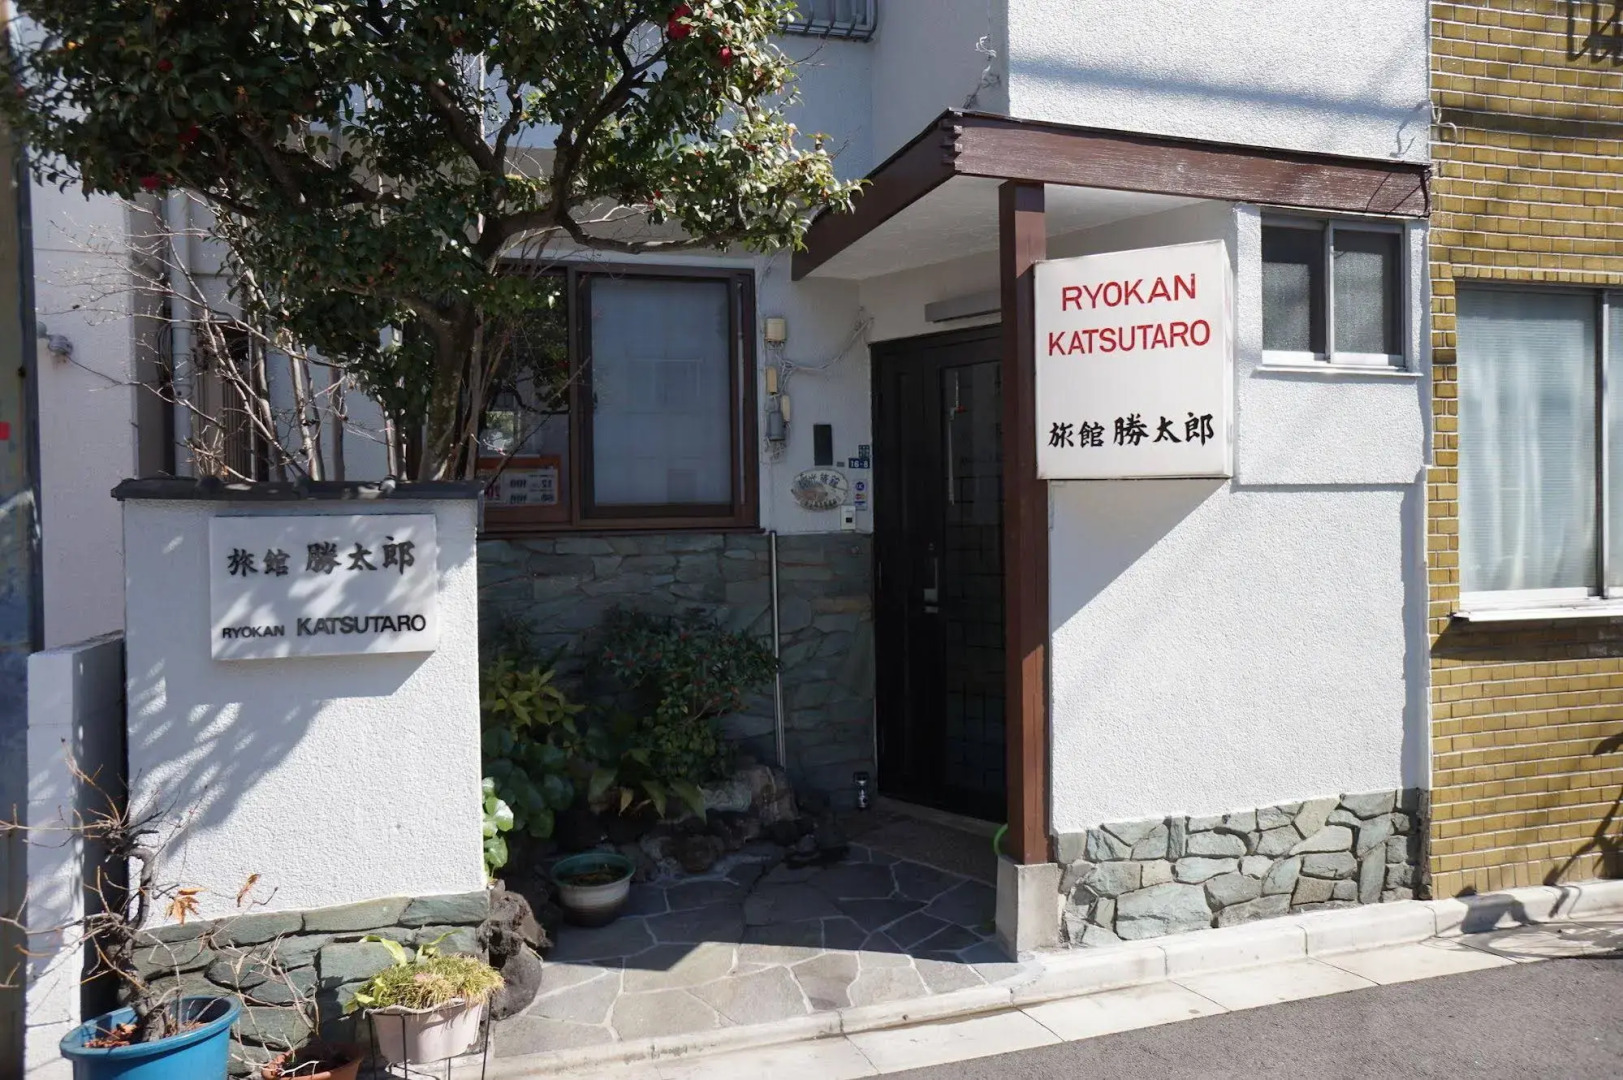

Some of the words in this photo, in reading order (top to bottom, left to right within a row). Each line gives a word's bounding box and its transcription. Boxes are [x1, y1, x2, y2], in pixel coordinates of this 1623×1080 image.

[1062, 273, 1196, 312] RYOKAN
[1048, 319, 1211, 357] KATSUTARO
[1049, 420, 1106, 449] 旅館
[1113, 411, 1215, 447] 勝太郎
[227, 547, 292, 577] 旅館
[305, 535, 416, 575] 勝太郎
[222, 625, 285, 639] RYOKAN
[297, 614, 427, 637] KATSUTARO
